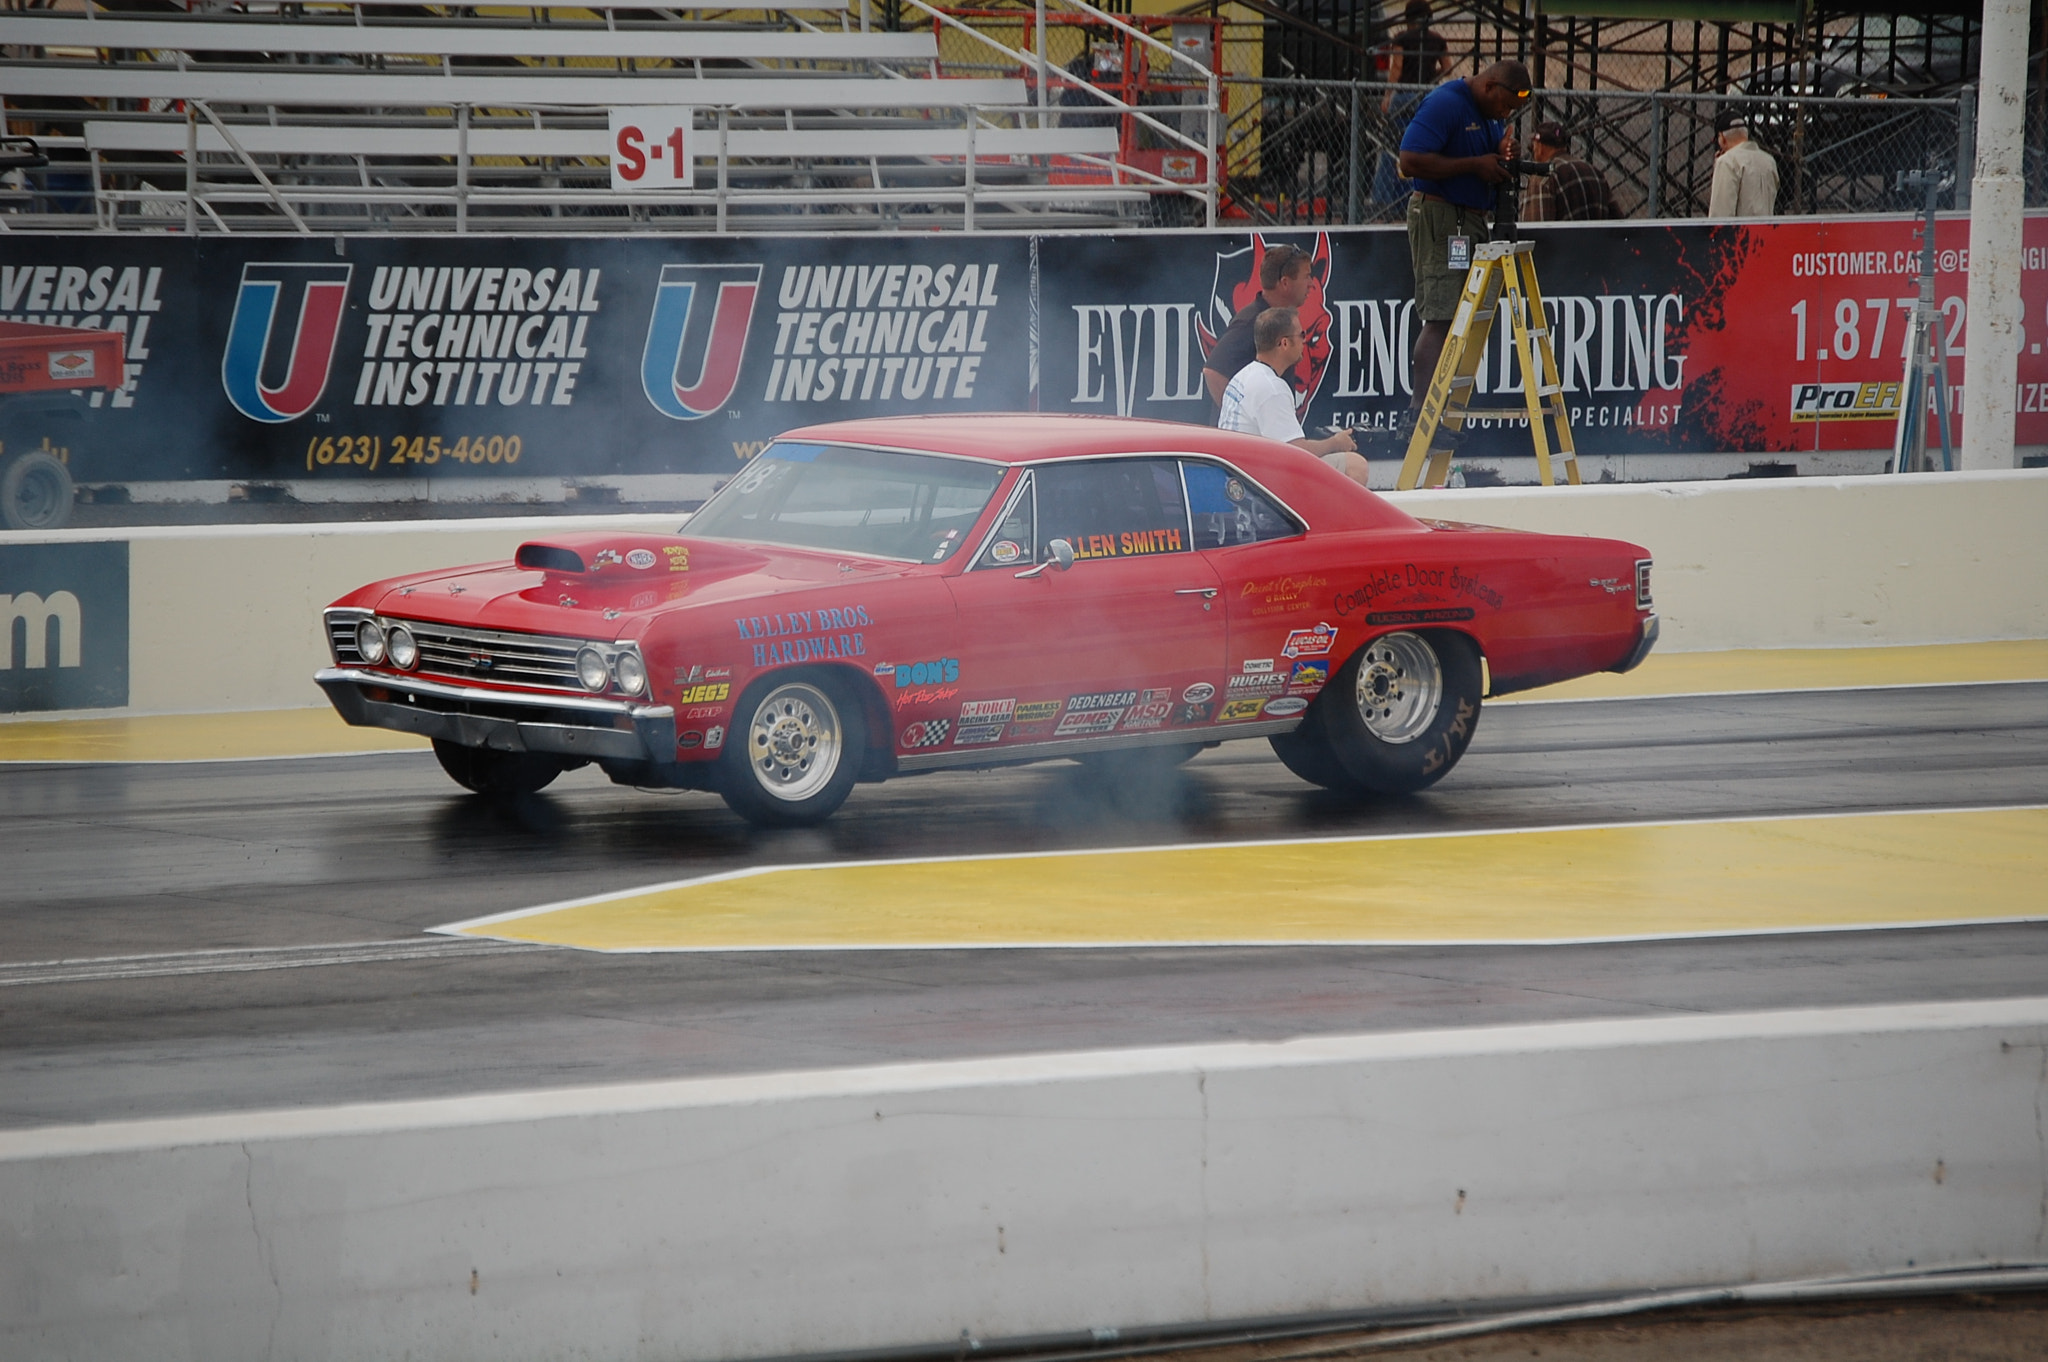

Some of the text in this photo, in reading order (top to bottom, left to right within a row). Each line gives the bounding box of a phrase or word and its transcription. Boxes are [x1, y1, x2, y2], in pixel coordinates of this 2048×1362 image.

[616, 126, 684, 181] S-1
[369, 267, 600, 312] UNIVERSAL
[778, 264, 999, 308] UNIVERSAL
[364, 314, 588, 359] TECHNICAL
[773, 310, 987, 355] TECHNICAL
[1071, 303, 1203, 417] EVIL
[354, 362, 580, 407] INSTITUTE
[764, 356, 982, 401] INSTITUTE
[1571, 404, 1682, 427] PECIALIST
[307, 435, 521, 471] (623) 245-4600
[1066, 528, 1181, 560] LLEN SMITH
[1334, 563, 1504, 616] Complete Door Systems
[735, 605, 874, 641] KELLEY BROS.
[1423, 610, 1471, 620] ARIZONA
[753, 633, 866, 667] HARDWARE
[895, 657, 959, 688] DON'S
[1229, 673, 1287, 687] HUGHES
[682, 683, 730, 704] JEG'S
[962, 700, 1014, 717] G-FORCE
[1017, 703, 1059, 713] PAINLESS
[1067, 692, 1136, 710] DEDENBEAR
[960, 713, 1010, 724] RACING GEAR
[1063, 712, 1109, 726] COMP
[1127, 703, 1169, 720] MSD
